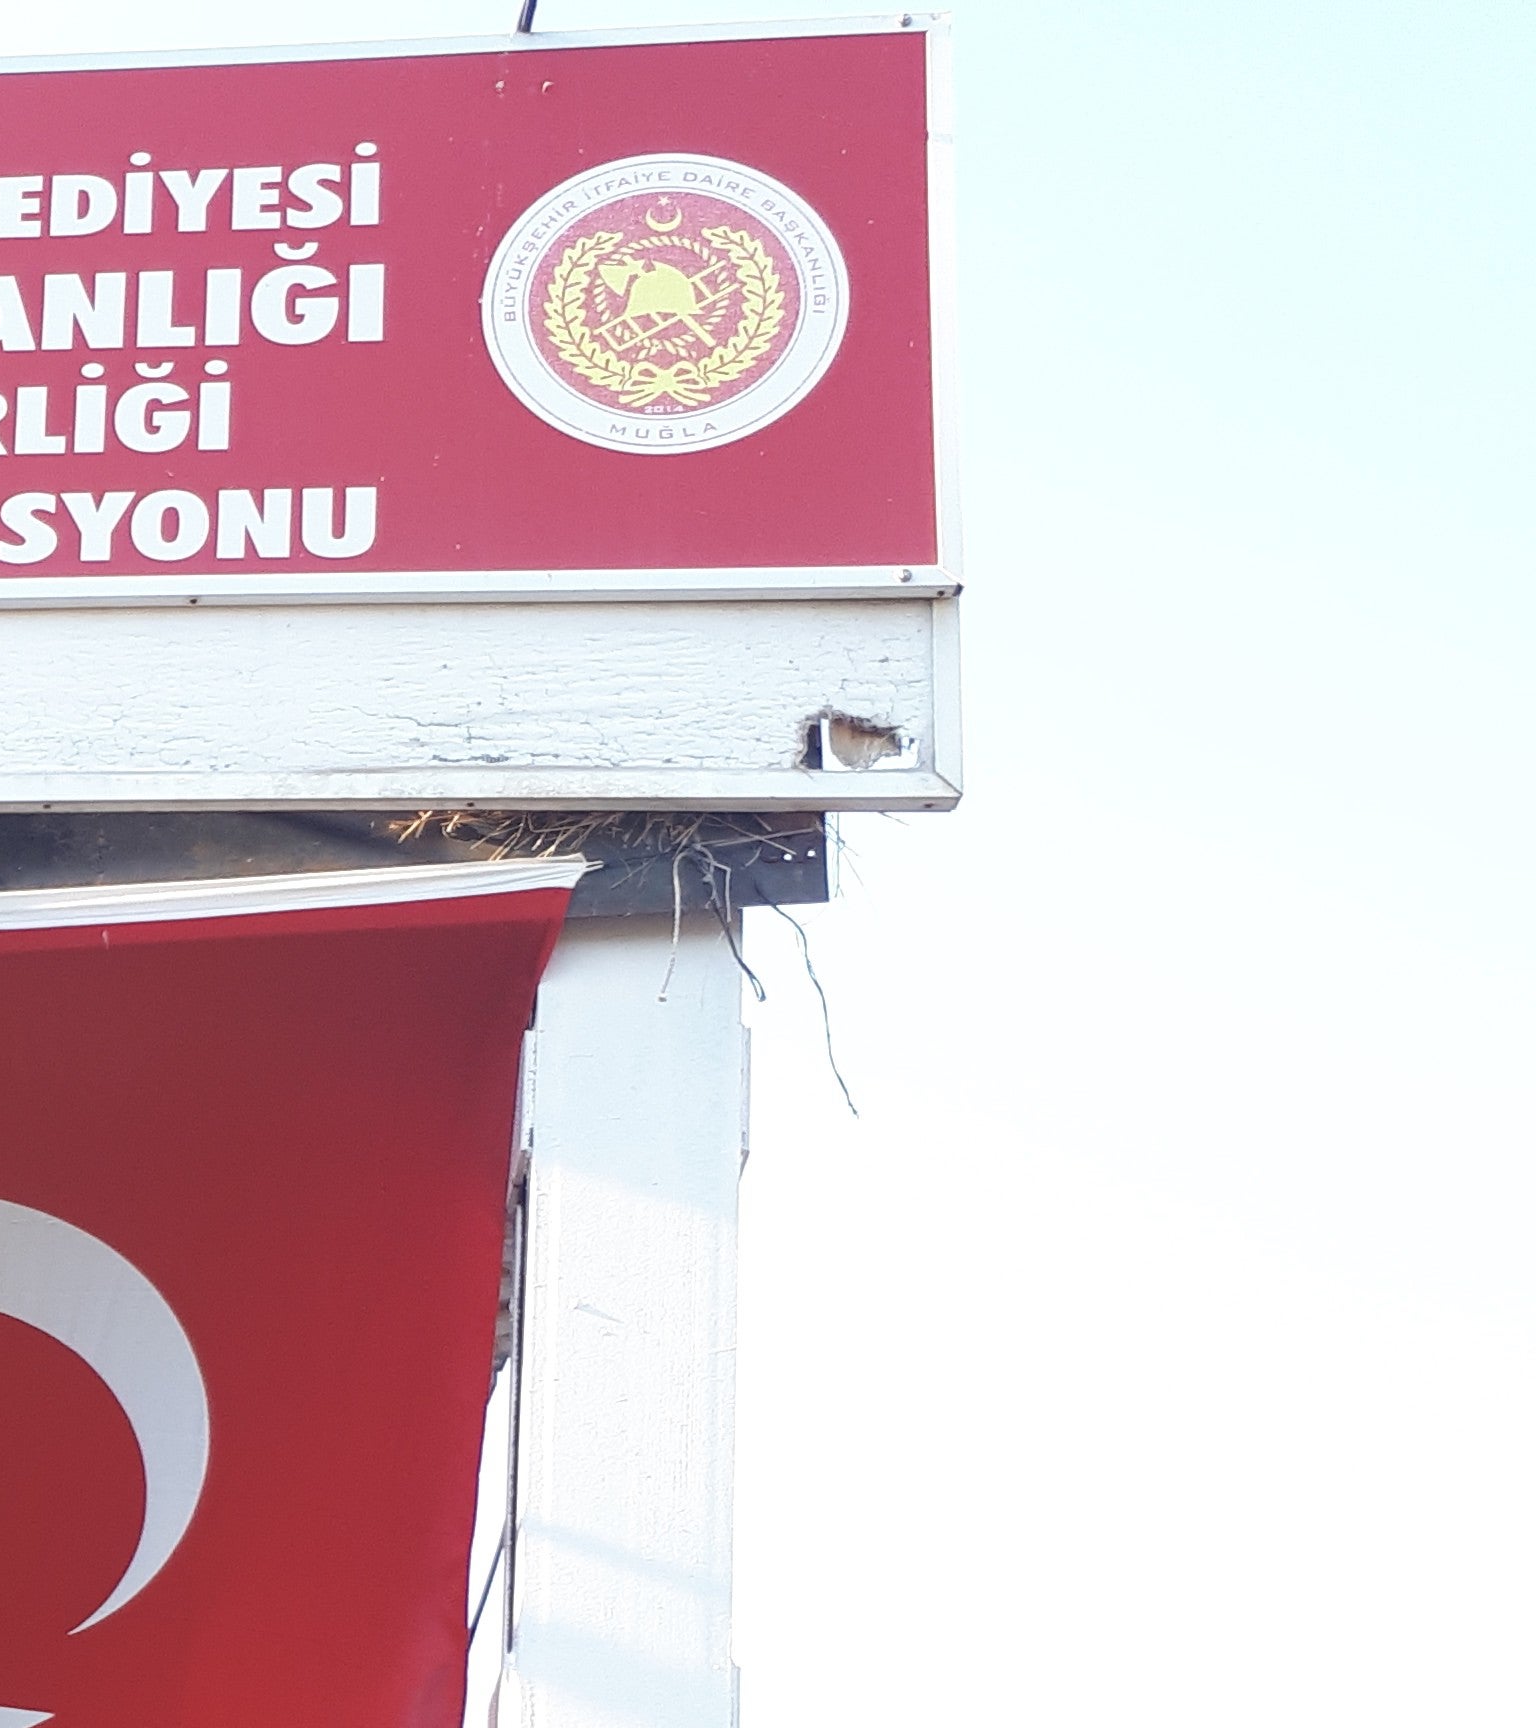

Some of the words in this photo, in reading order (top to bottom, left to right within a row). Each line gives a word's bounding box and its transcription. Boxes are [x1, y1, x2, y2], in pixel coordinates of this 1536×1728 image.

[500, 198, 579, 322] BÜYÜKŞEHİR
[581, 169, 673, 202] İTFAİYE
[682, 170, 755, 200] DAİRE
[760, 198, 832, 315] BAŞKANLIĞI
[643, 404, 686, 415] 2014
[608, 421, 719, 441] MUĞLA
